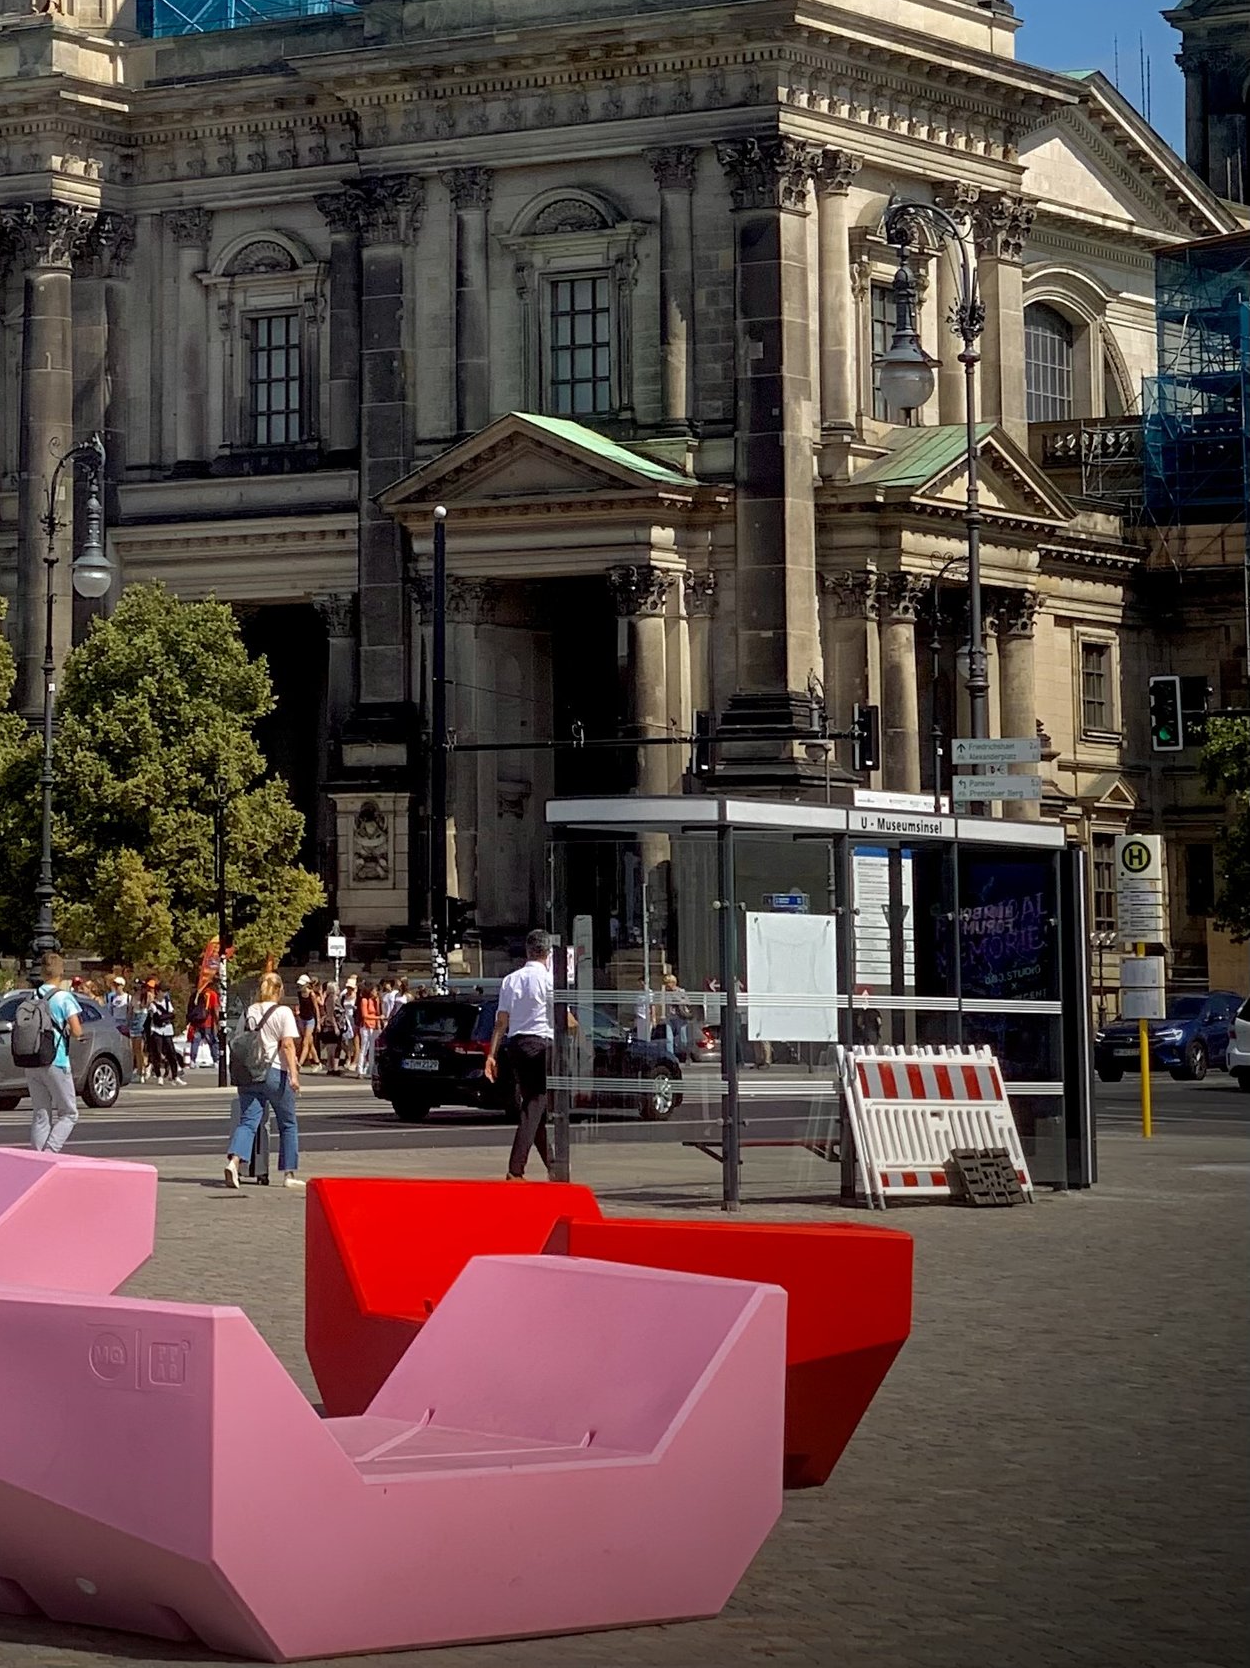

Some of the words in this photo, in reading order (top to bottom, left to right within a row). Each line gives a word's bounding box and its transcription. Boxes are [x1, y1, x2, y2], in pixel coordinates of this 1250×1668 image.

[861, 817, 868, 829] U
[877, 817, 943, 834] Museumsinsel
[1128, 848, 1143, 866] H
